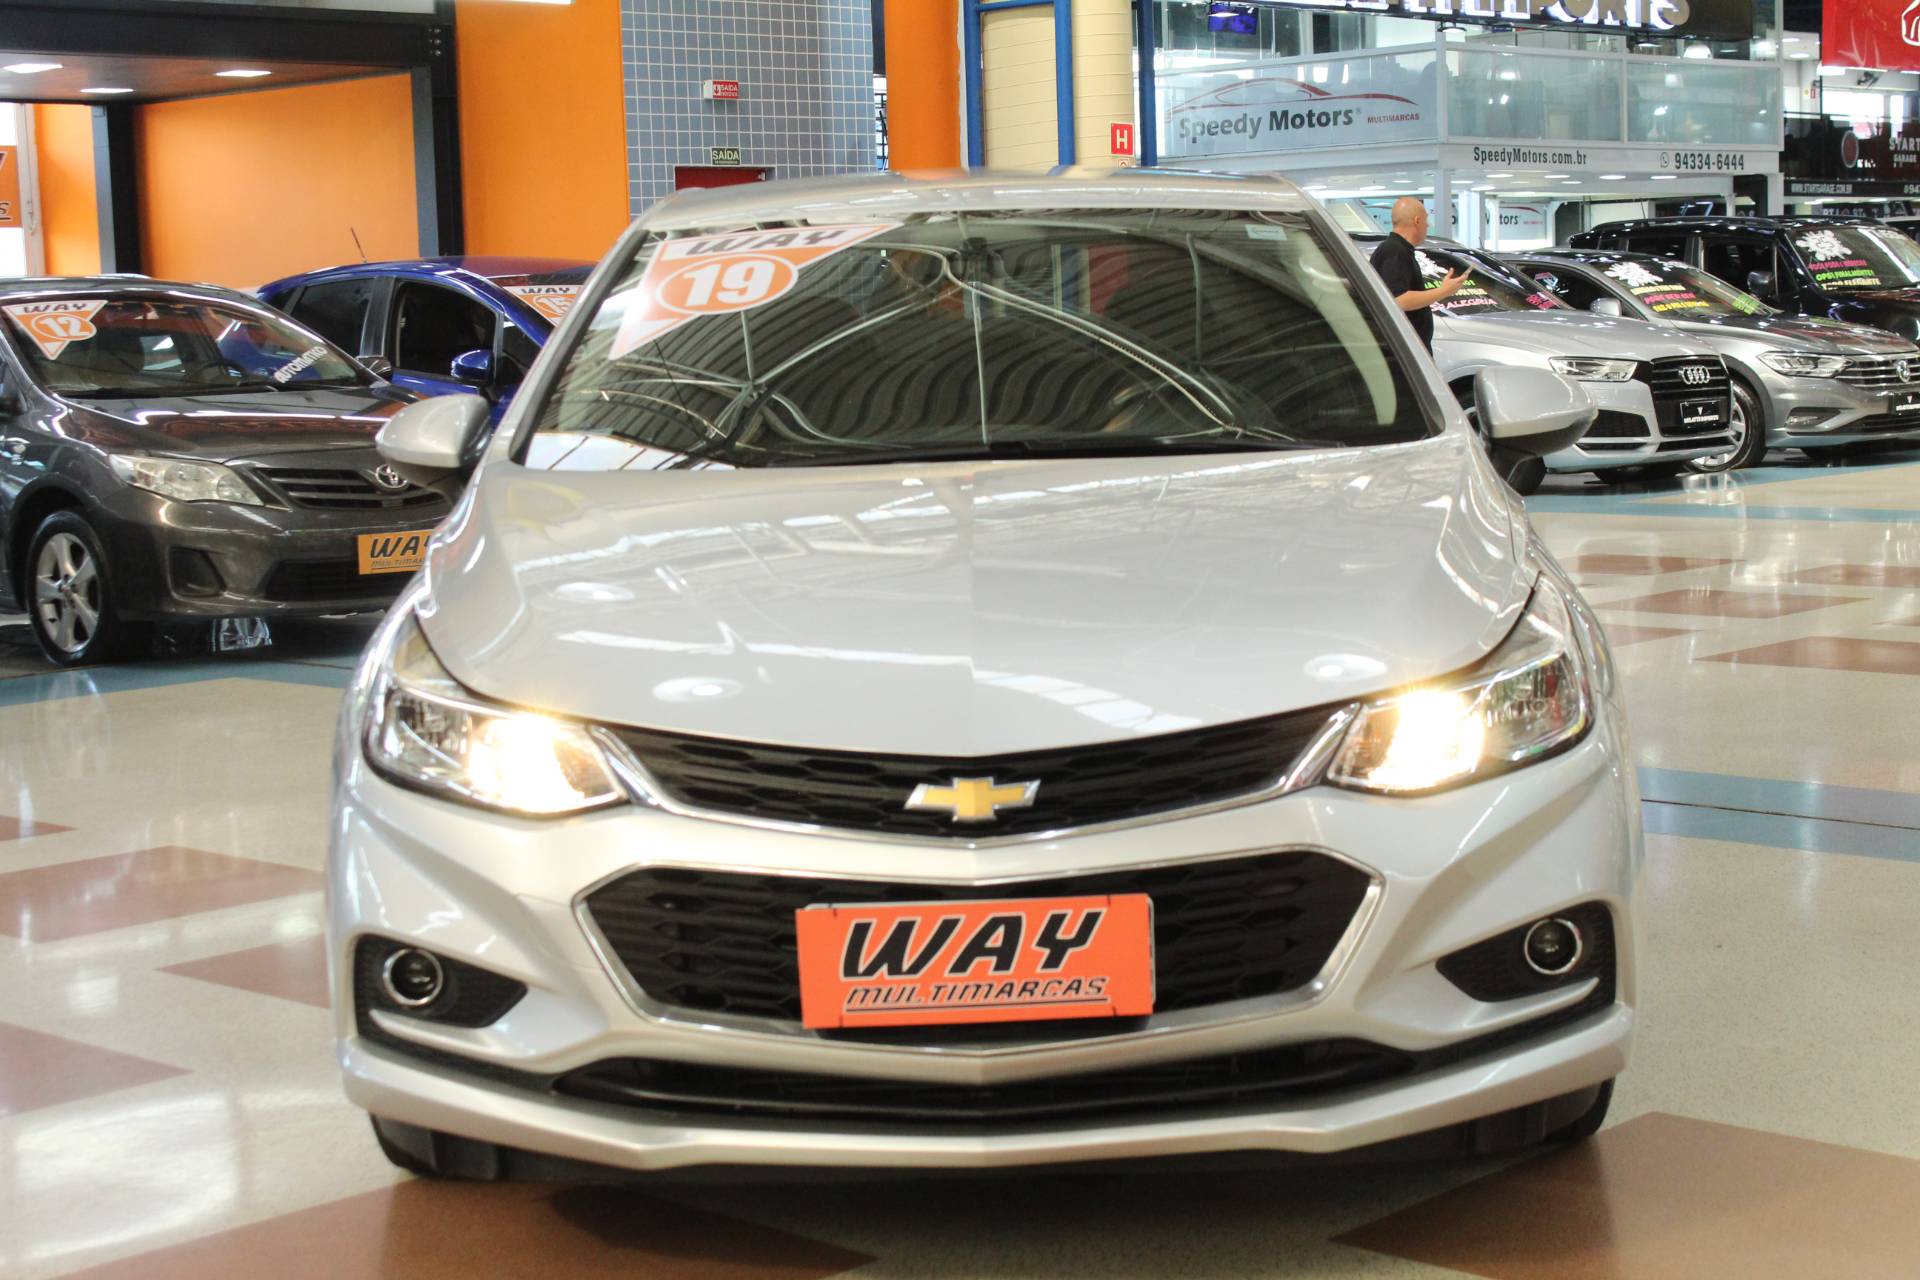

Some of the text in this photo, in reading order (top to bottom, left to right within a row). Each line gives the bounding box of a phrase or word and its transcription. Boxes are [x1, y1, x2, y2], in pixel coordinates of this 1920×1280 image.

[1179, 108, 1354, 144] Speedy Motors
[1367, 112, 1420, 124] MULTIMARCAS
[1116, 128, 1128, 149] H
[712, 148, 740, 160] SAÍDA
[1473, 146, 1587, 165] SpeedyMotors.com.br
[1675, 152, 1745, 170] 94334-6444
[686, 230, 846, 255] WAY
[683, 259, 776, 307] 19
[23, 303, 87, 313] WAY
[41, 314, 91, 339] 12
[841, 908, 1107, 982] WAY
[846, 976, 1109, 1006] MULTIMARCAS
